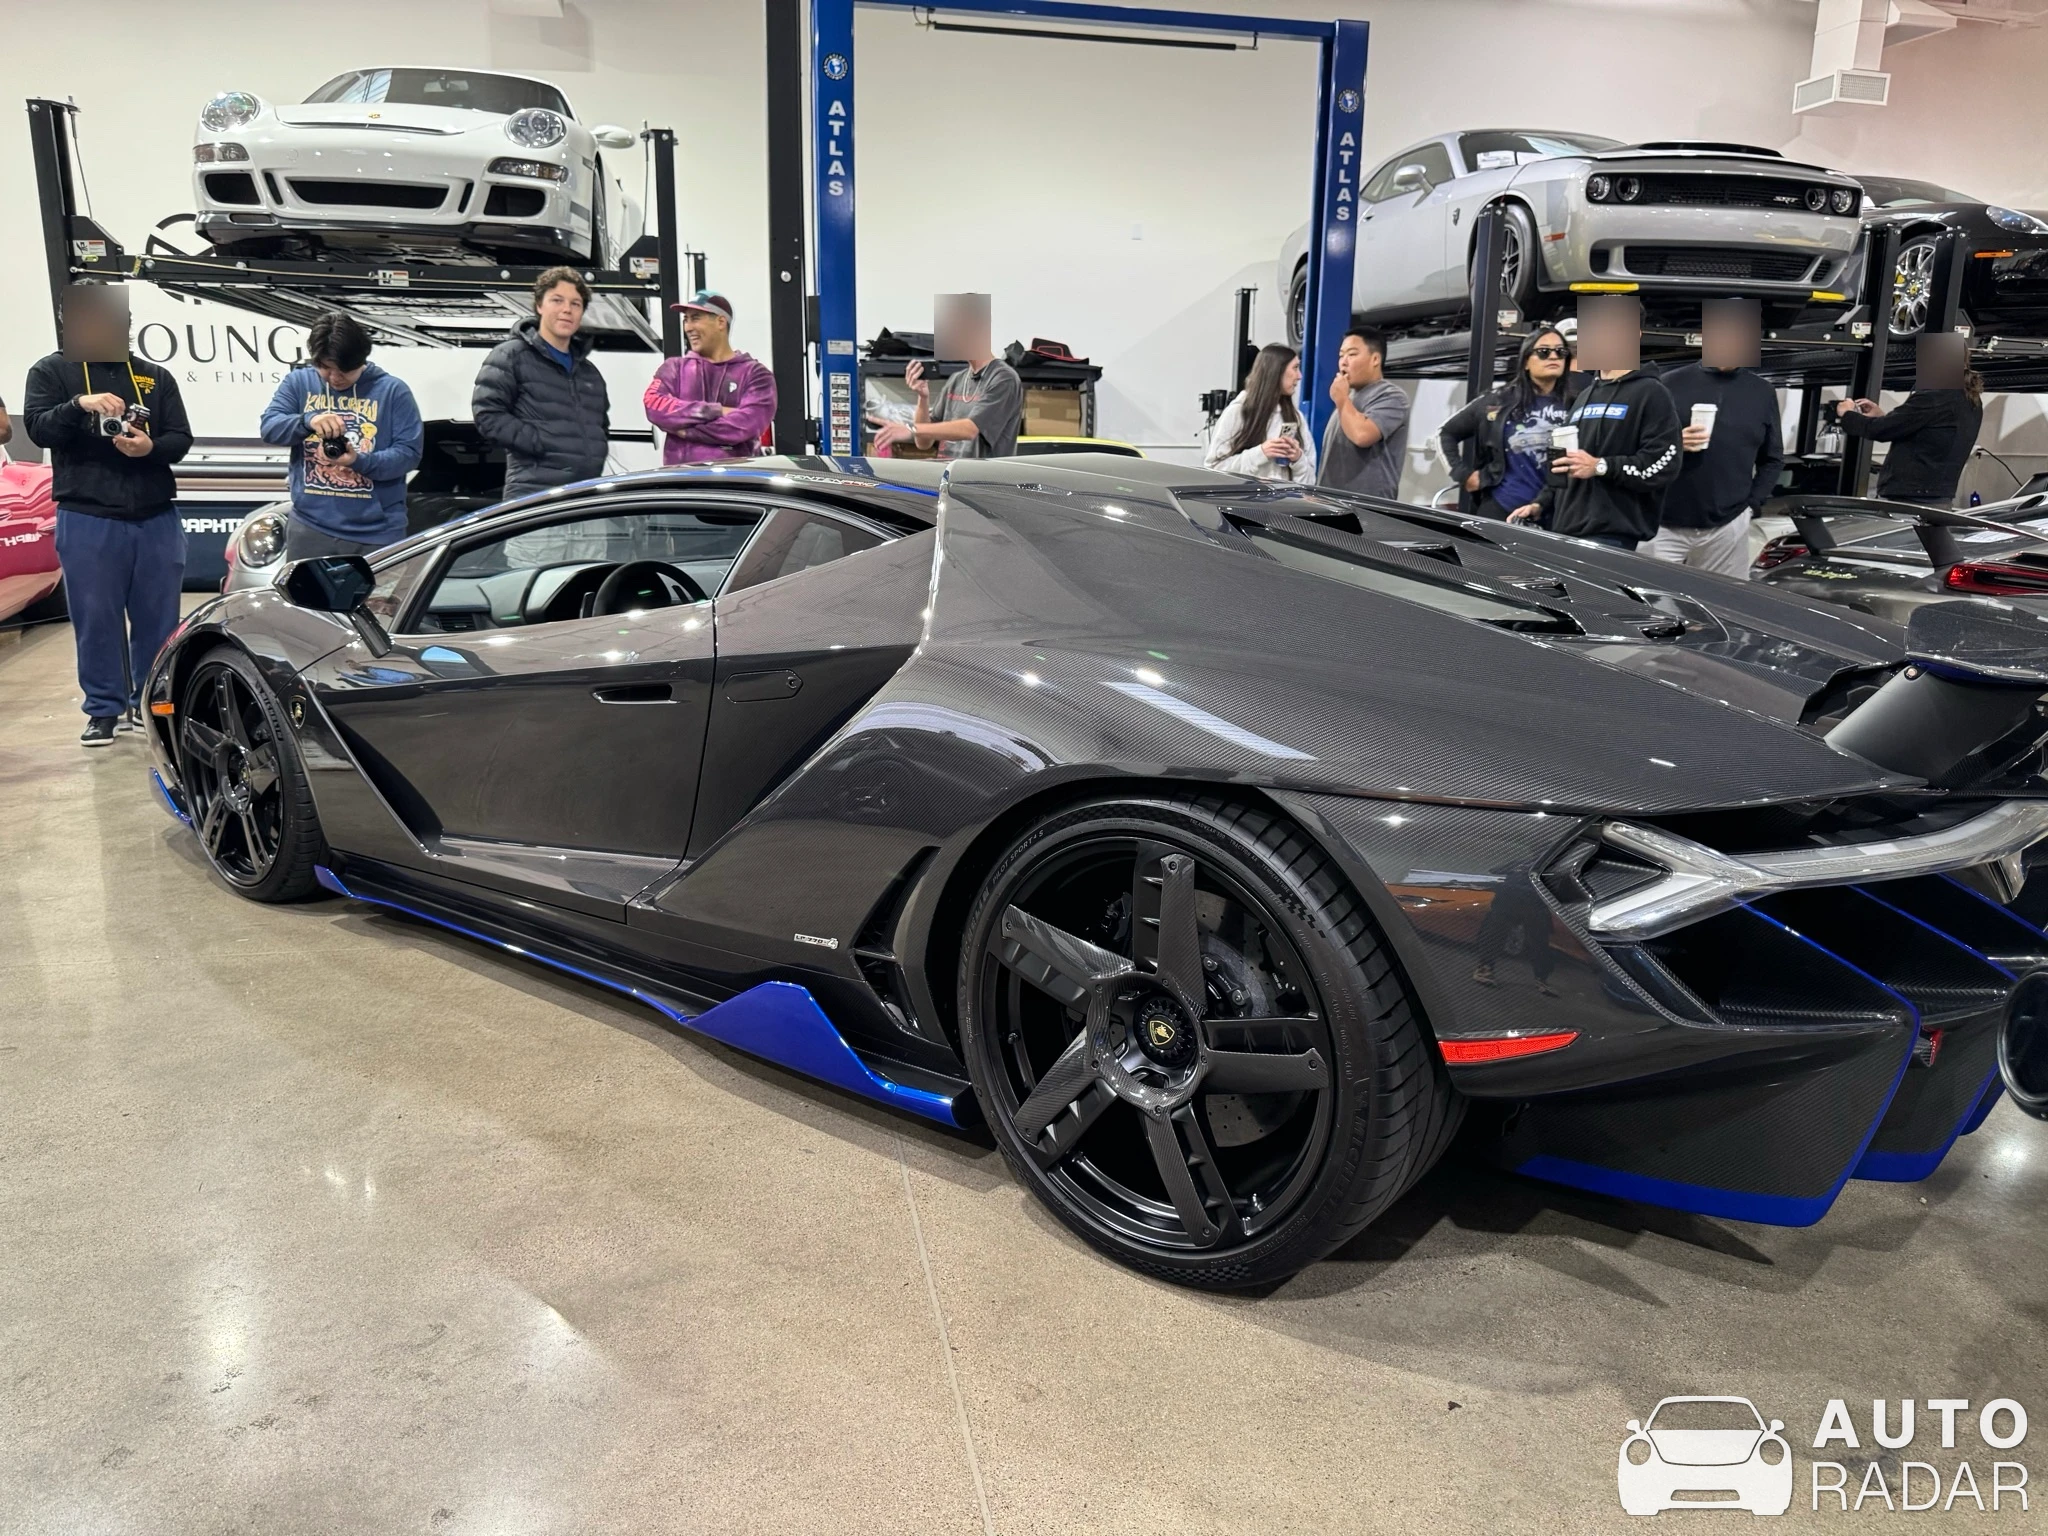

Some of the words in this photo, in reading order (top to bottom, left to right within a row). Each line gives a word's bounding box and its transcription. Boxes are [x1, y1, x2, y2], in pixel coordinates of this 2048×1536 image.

[828, 101, 847, 196] ATLAS
[1336, 132, 1355, 221] ATLAS
[137, 323, 302, 364] OUNG
[187, 371, 198, 383] &
[216, 371, 281, 383] FINIS
